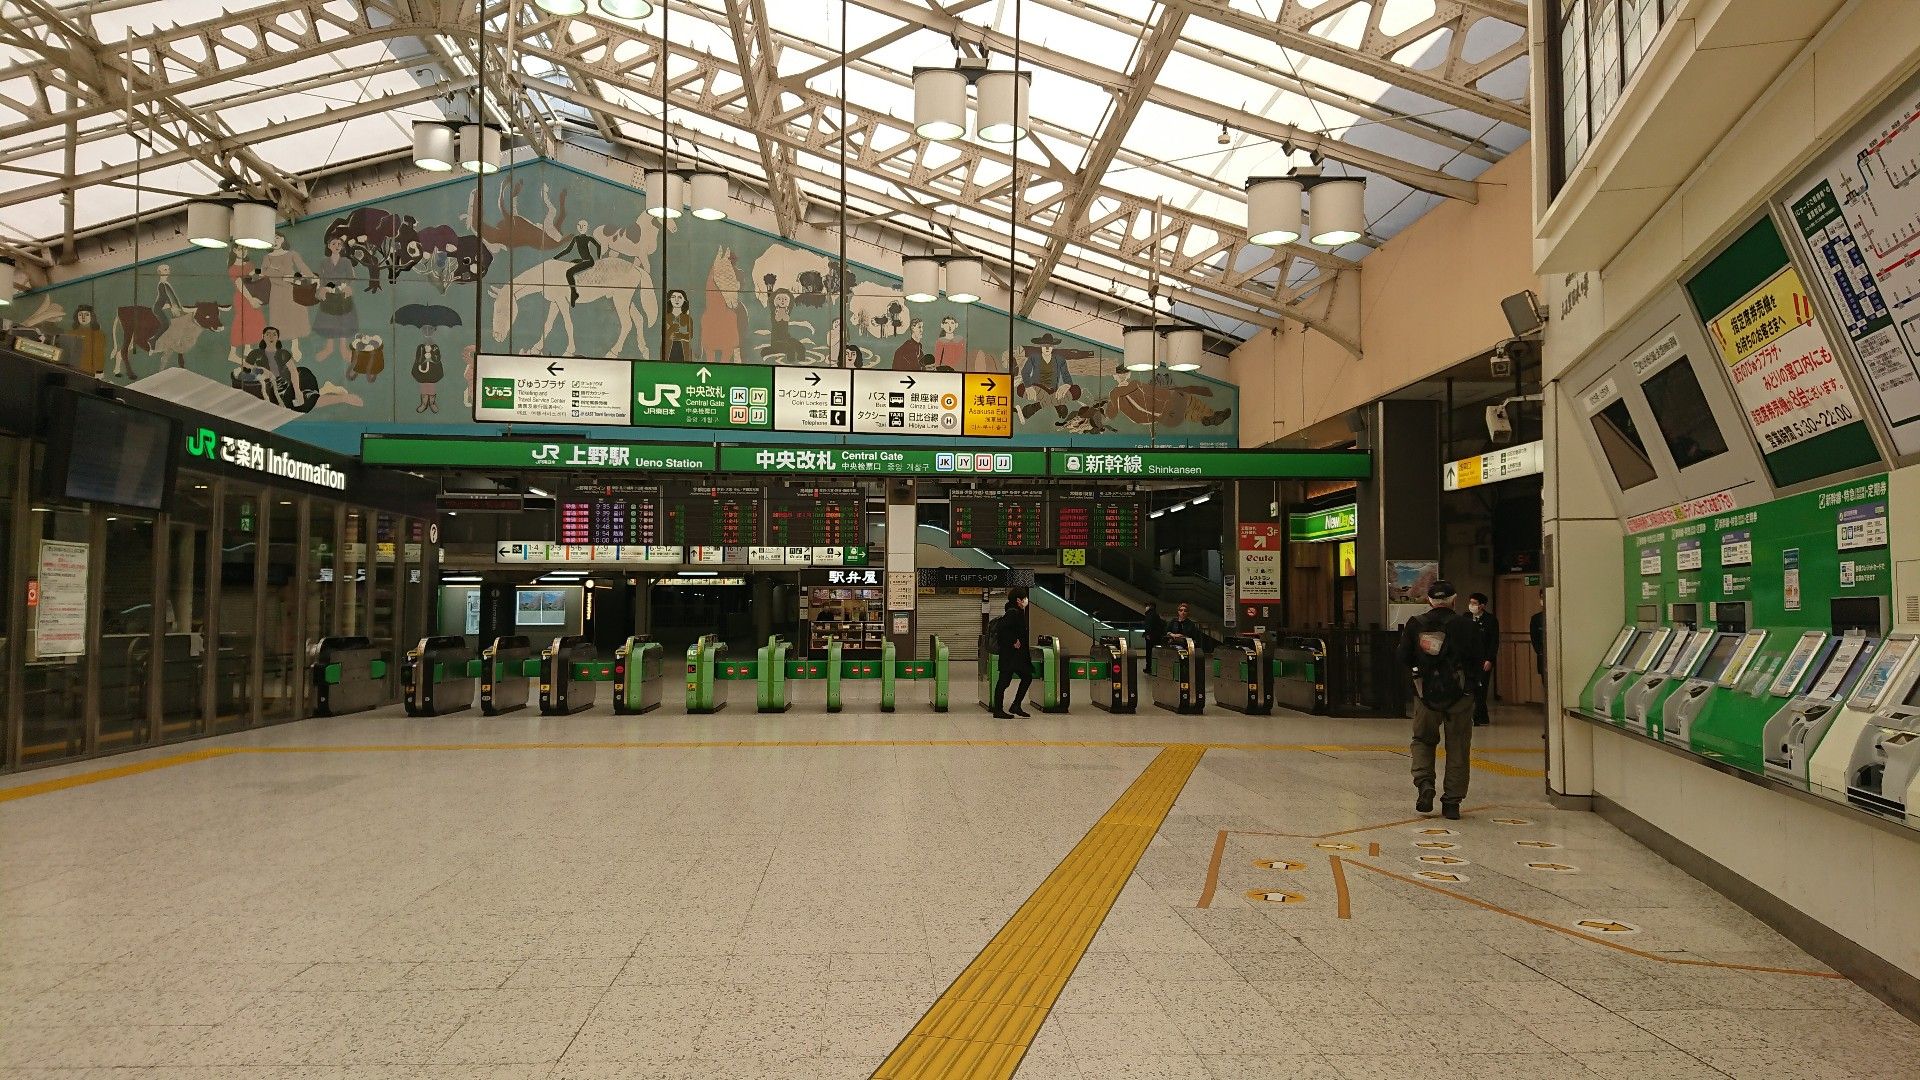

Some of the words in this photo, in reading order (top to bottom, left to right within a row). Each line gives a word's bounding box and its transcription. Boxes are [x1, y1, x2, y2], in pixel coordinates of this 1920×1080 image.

[1730, 294, 1778, 336] 指定席券売機を
[1735, 315, 1787, 355] お待ちのお客さまへ
[1762, 346, 1833, 391] みどりの窓口内にも
[517, 379, 566, 389] びゅうプラザ
[484, 386, 512, 397] びゅう
[638, 383, 681, 408] JR
[685, 385, 726, 399] 中央改札
[734, 392, 744, 400] JK
[778, 389, 828, 399] コインロッカー
[868, 392, 887, 401] バス
[910, 393, 939, 403] 銀座線
[973, 394, 1008, 407] 浅草口
[643, 408, 676, 416] JR東日本
[808, 409, 828, 419] 電話
[857, 411, 887, 420] タクシー
[908, 412, 939, 422] 日比谷線
[1764, 424, 1798, 449] 営業時間
[186, 428, 216, 460] JR
[531, 444, 560, 460] JR
[565, 445, 630, 467] 上野駅
[841, 451, 878, 461] Central
[880, 451, 904, 461] Gate
[220, 436, 264, 471] ご案内
[266, 447, 345, 491] Information
[635, 457, 663, 467] Ueno
[665, 457, 703, 468] Station
[756, 449, 836, 471] 中央改札
[939, 458, 950, 467] JK
[959, 458, 970, 467] JY
[978, 458, 989, 467] JU
[998, 458, 1008, 467] JJ
[1085, 454, 1143, 474] 新幹線
[1148, 464, 1202, 475] Shinkansen
[1325, 512, 1355, 530] NewDays
[1266, 526, 1279, 537] 3F
[1246, 554, 1274, 562] ecute
[828, 570, 877, 585] 駅弁屋
[960, 574, 977, 582] GIFT
[978, 574, 998, 582] SHOP
